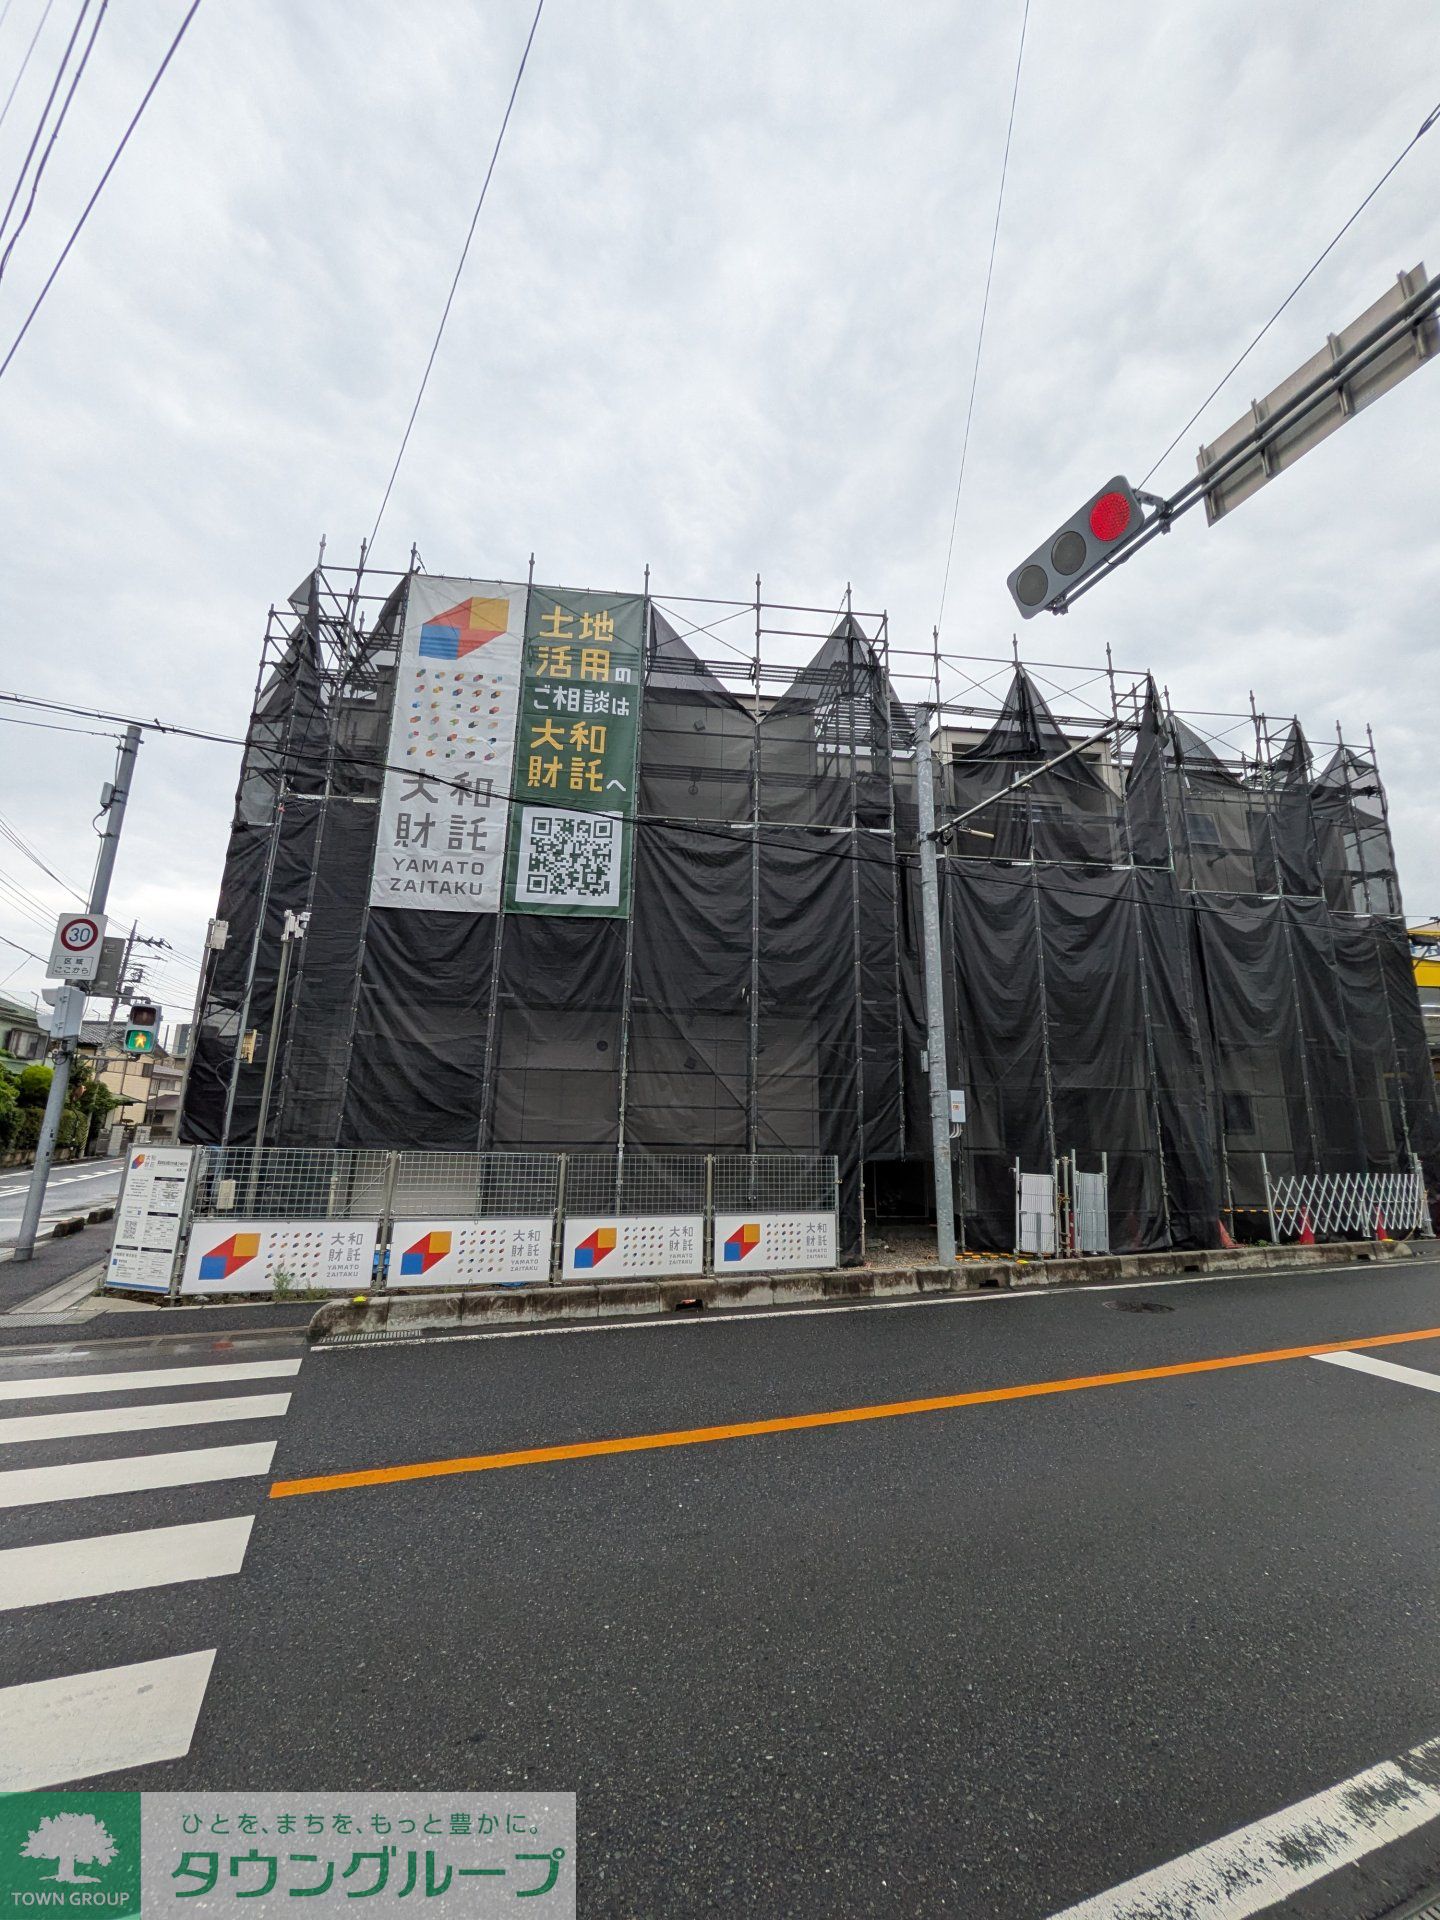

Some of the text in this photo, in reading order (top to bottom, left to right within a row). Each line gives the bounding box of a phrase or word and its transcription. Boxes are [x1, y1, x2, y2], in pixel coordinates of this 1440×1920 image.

[539, 605, 614, 642] 土地
[536, 646, 632, 684] 活用の
[533, 684, 630, 716] ご相談は
[530, 719, 607, 754] 大和
[528, 756, 627, 792] 財託へ
[400, 768, 494, 808] 大和
[393, 813, 488, 851] 財託
[392, 857, 485, 876] YAMATO
[390, 877, 482, 896] ZAITAKU
[69, 928, 90, 942] 30
[55, 966, 88, 974] ここから
[331, 1232, 364, 1246] 大和
[512, 1228, 541, 1242] 大和
[669, 1225, 694, 1238] 大和
[511, 1243, 540, 1257] 財託
[669, 1239, 694, 1251] 財託
[328, 1248, 361, 1262] 財託
